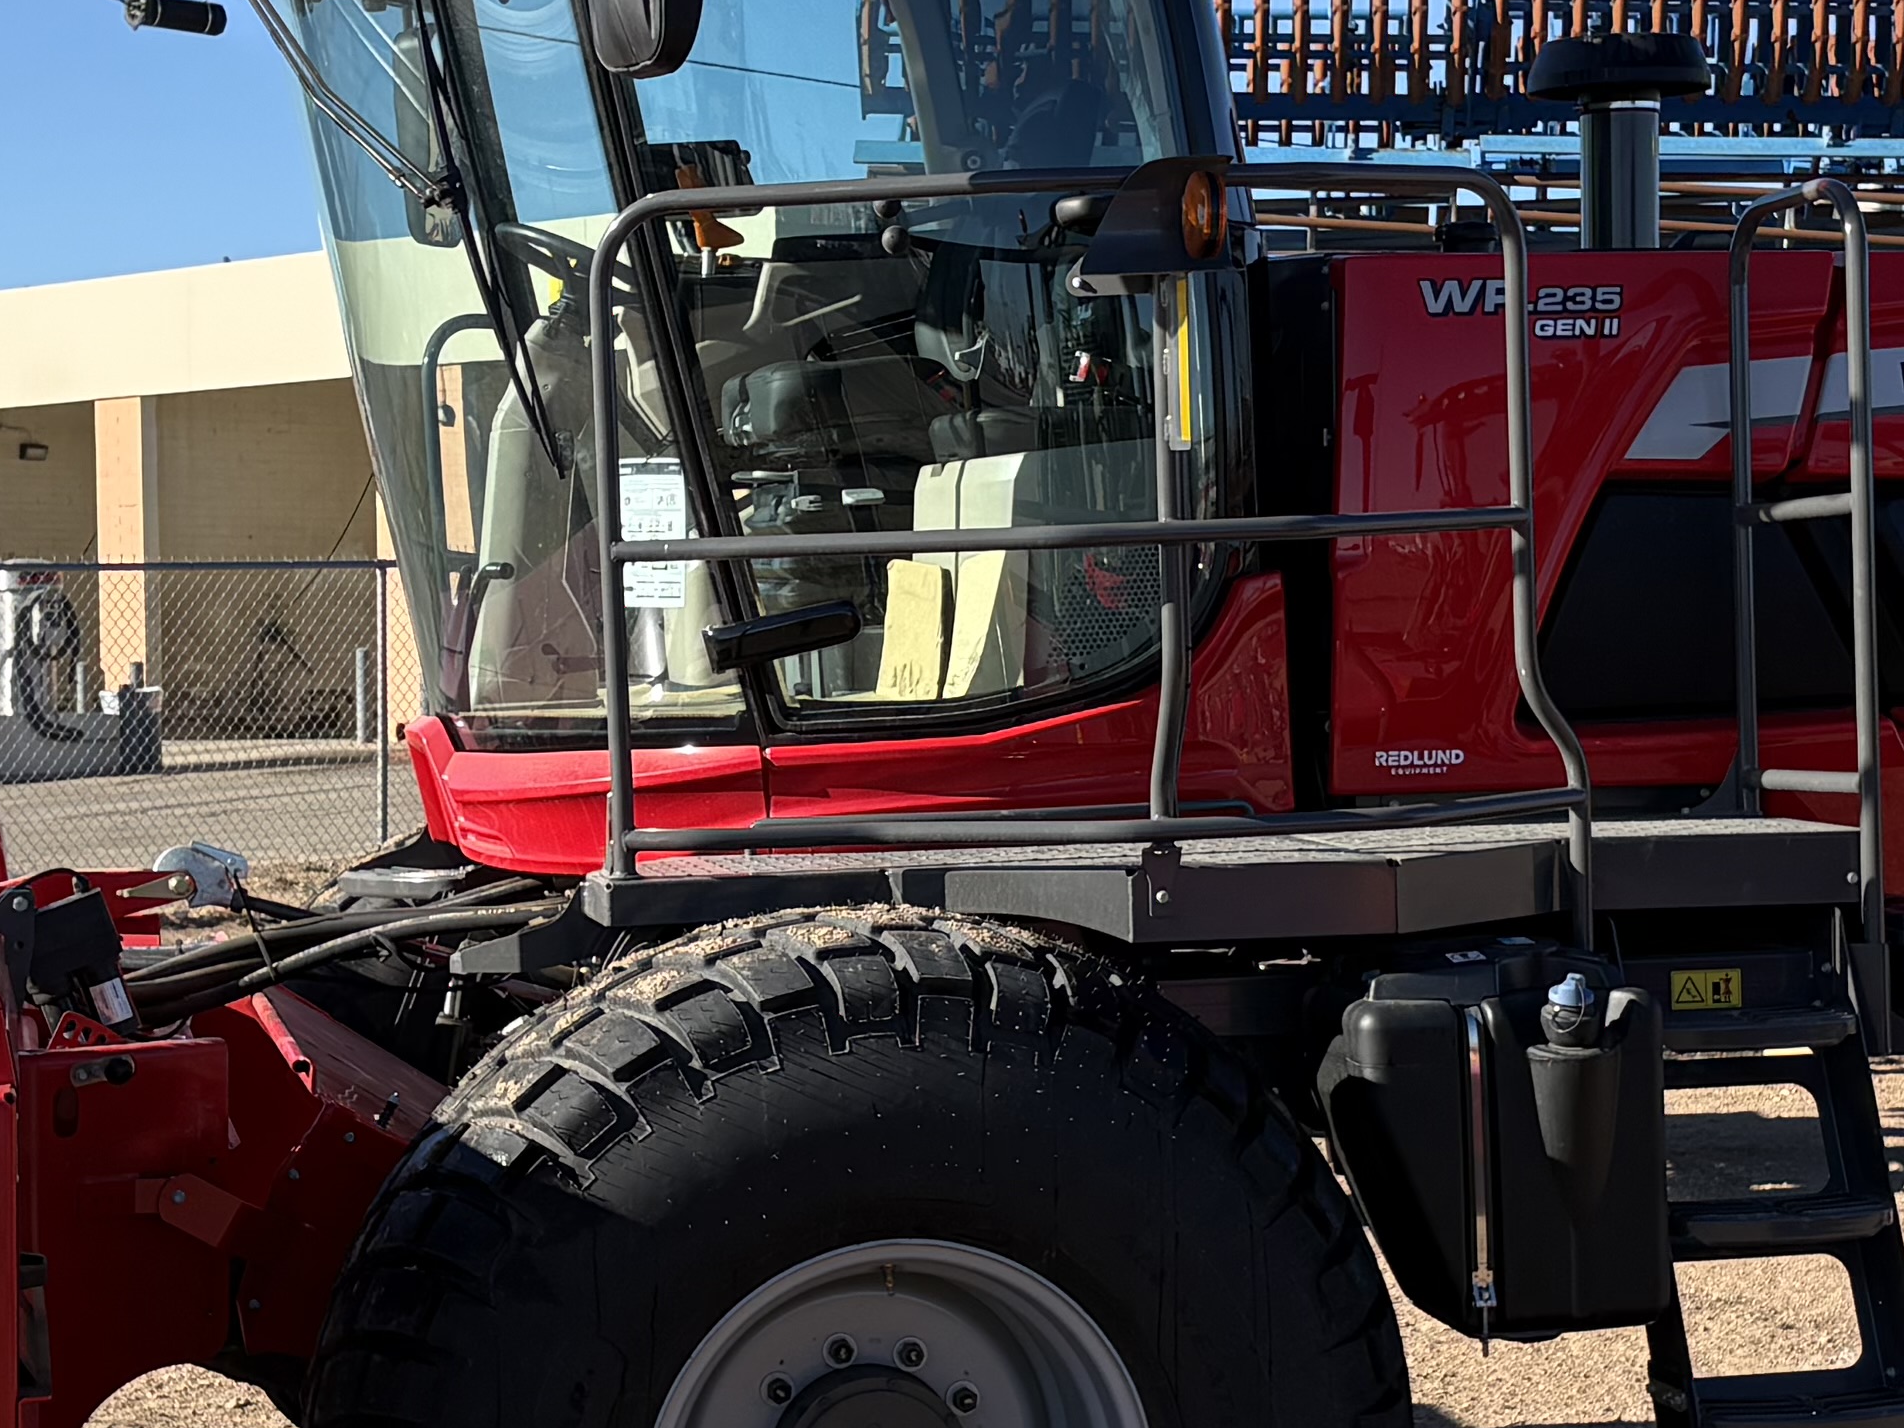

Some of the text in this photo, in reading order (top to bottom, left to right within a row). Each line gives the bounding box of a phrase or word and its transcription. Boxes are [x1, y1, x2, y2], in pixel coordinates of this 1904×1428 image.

[1534, 318, 1619, 337] GEN II
[1375, 749, 1465, 766] REDLUND
[1391, 766, 1448, 775] EQUIPMENT
